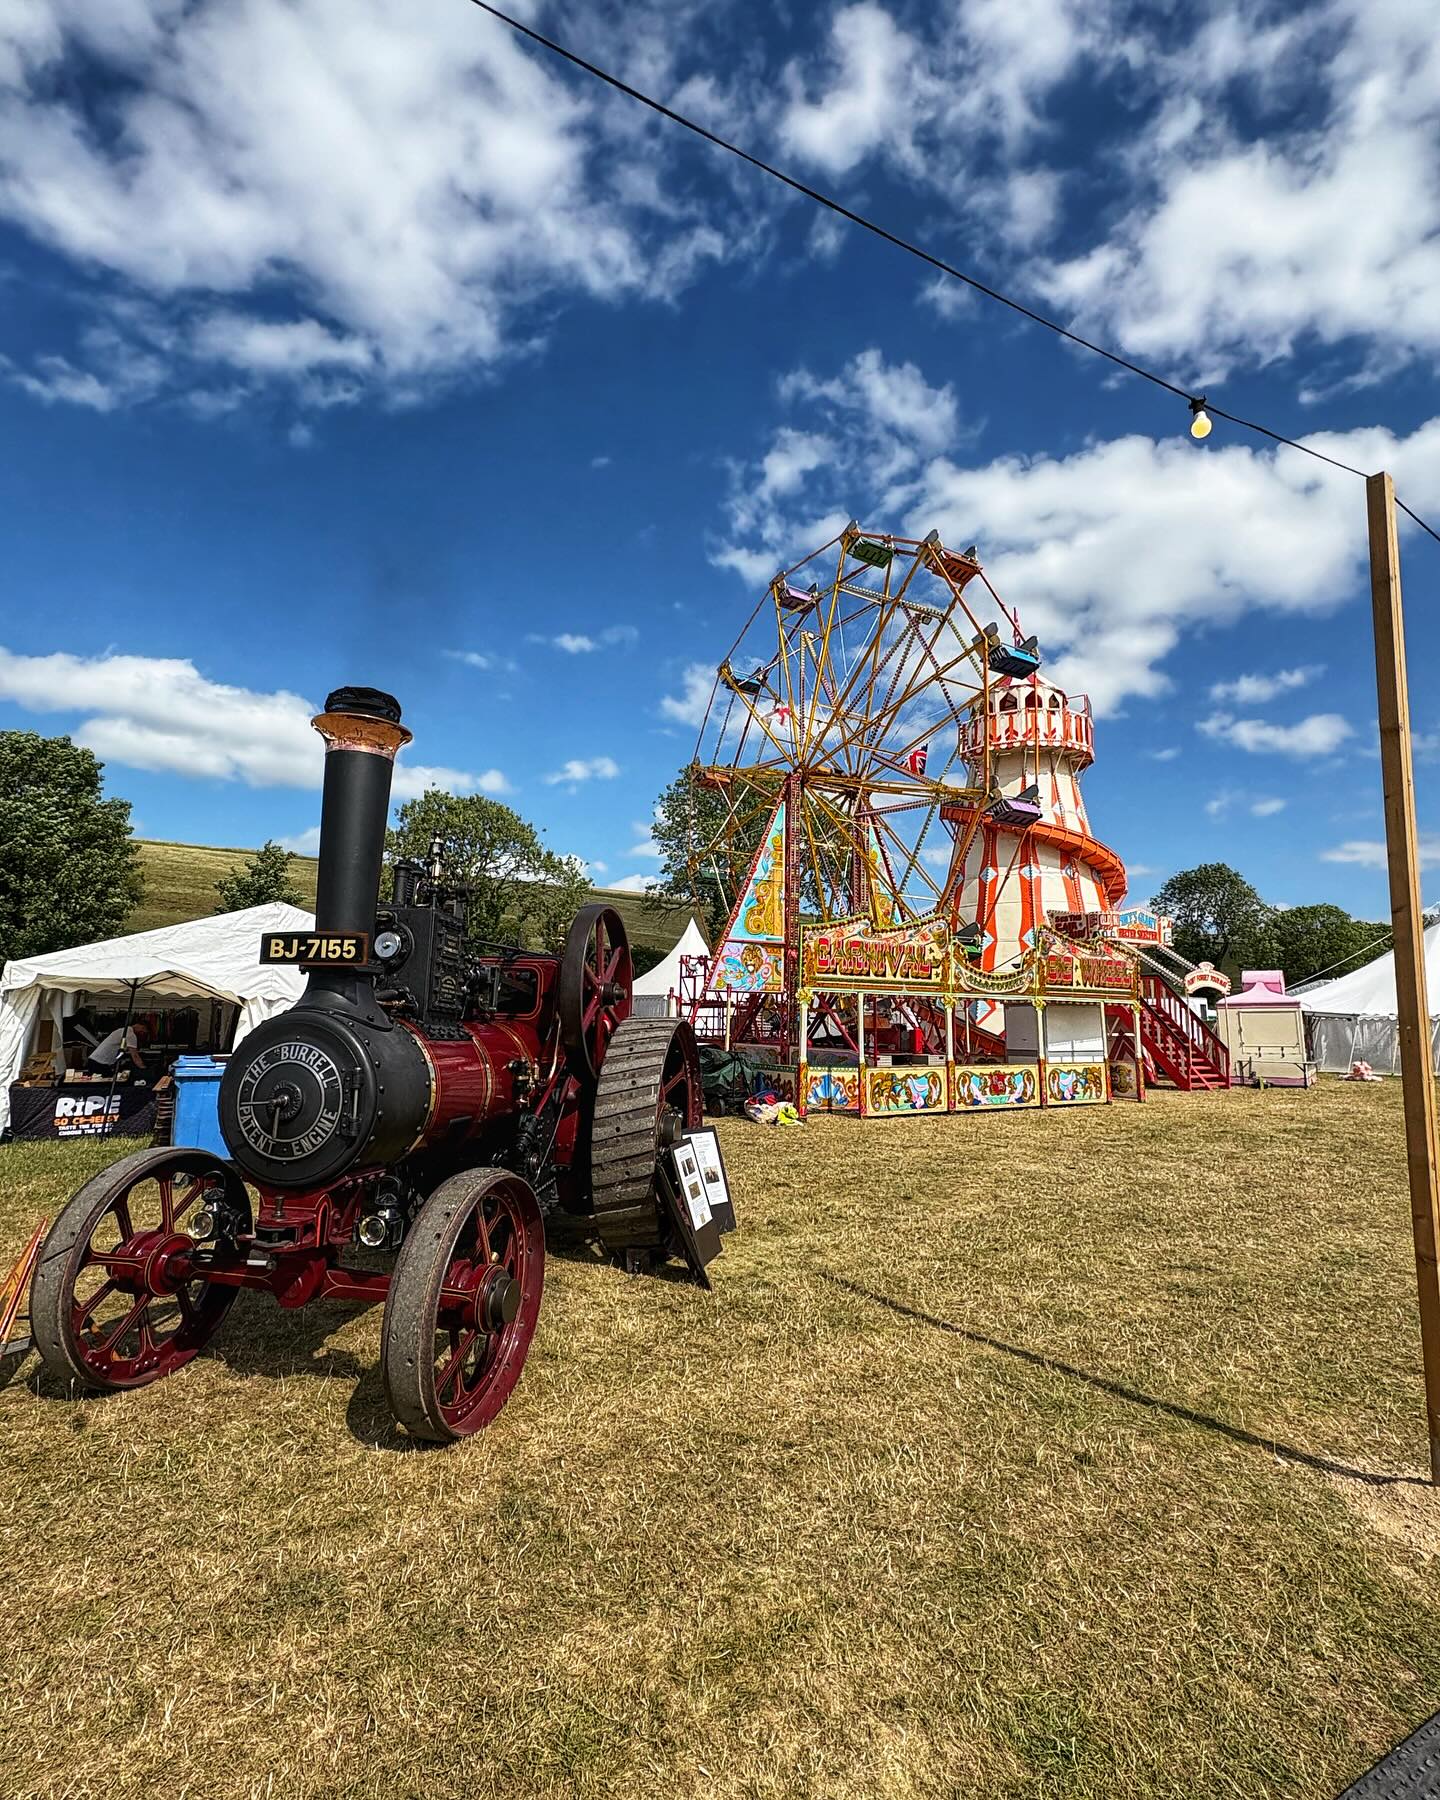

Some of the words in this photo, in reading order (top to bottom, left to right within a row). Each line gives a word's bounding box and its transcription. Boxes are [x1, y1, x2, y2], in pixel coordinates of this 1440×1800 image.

[269, 938, 357, 959] BJ-7155
[814, 936, 932, 977] CARNIVAL
[1046, 954, 1073, 985] BIG
[1080, 958, 1132, 988] WHEEL
[244, 1055, 271, 1084] THE
[53, 1117, 69, 1126] SO
[239, 1106, 277, 1154] PATENT
[291, 1108, 338, 1156] ENGINE
